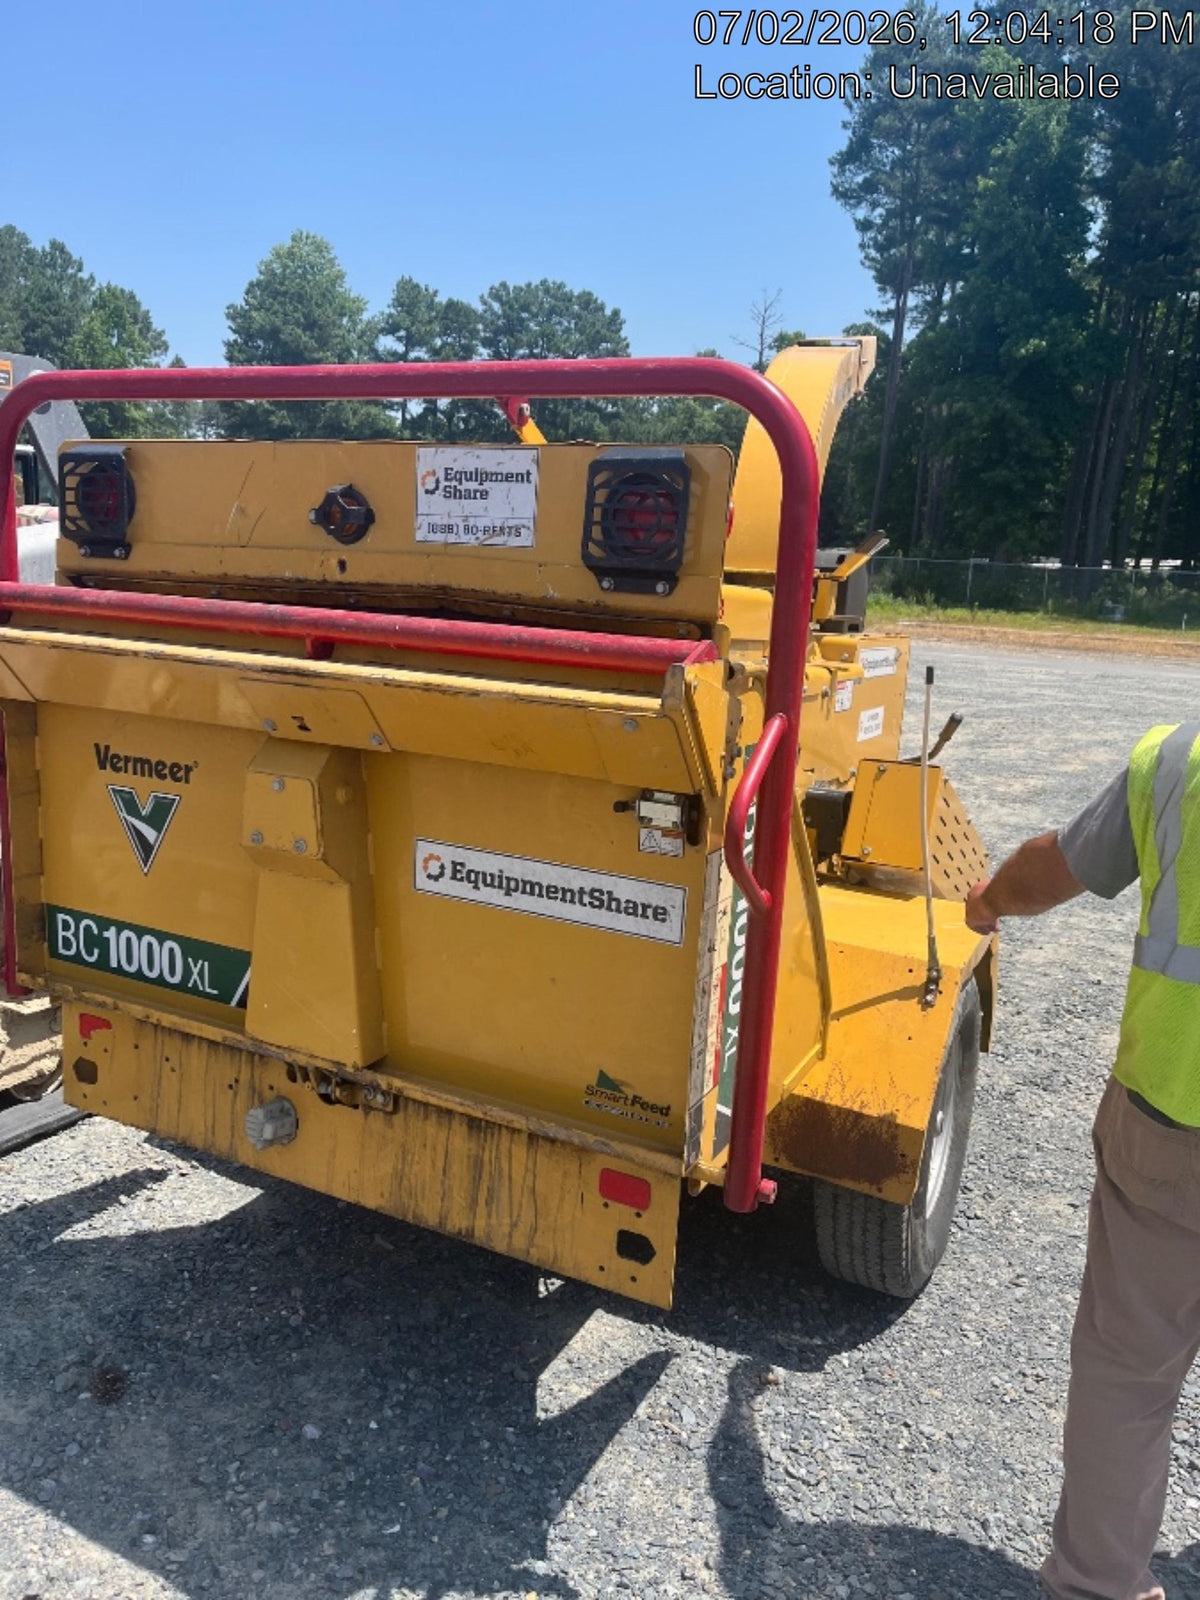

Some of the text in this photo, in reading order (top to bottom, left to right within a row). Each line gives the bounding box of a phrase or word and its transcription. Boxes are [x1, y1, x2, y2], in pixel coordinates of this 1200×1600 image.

[443, 466, 533, 486] Equipment
[442, 485, 490, 501] Share
[93, 742, 194, 785] Vermeer
[449, 860, 669, 924] EquipmentShare
